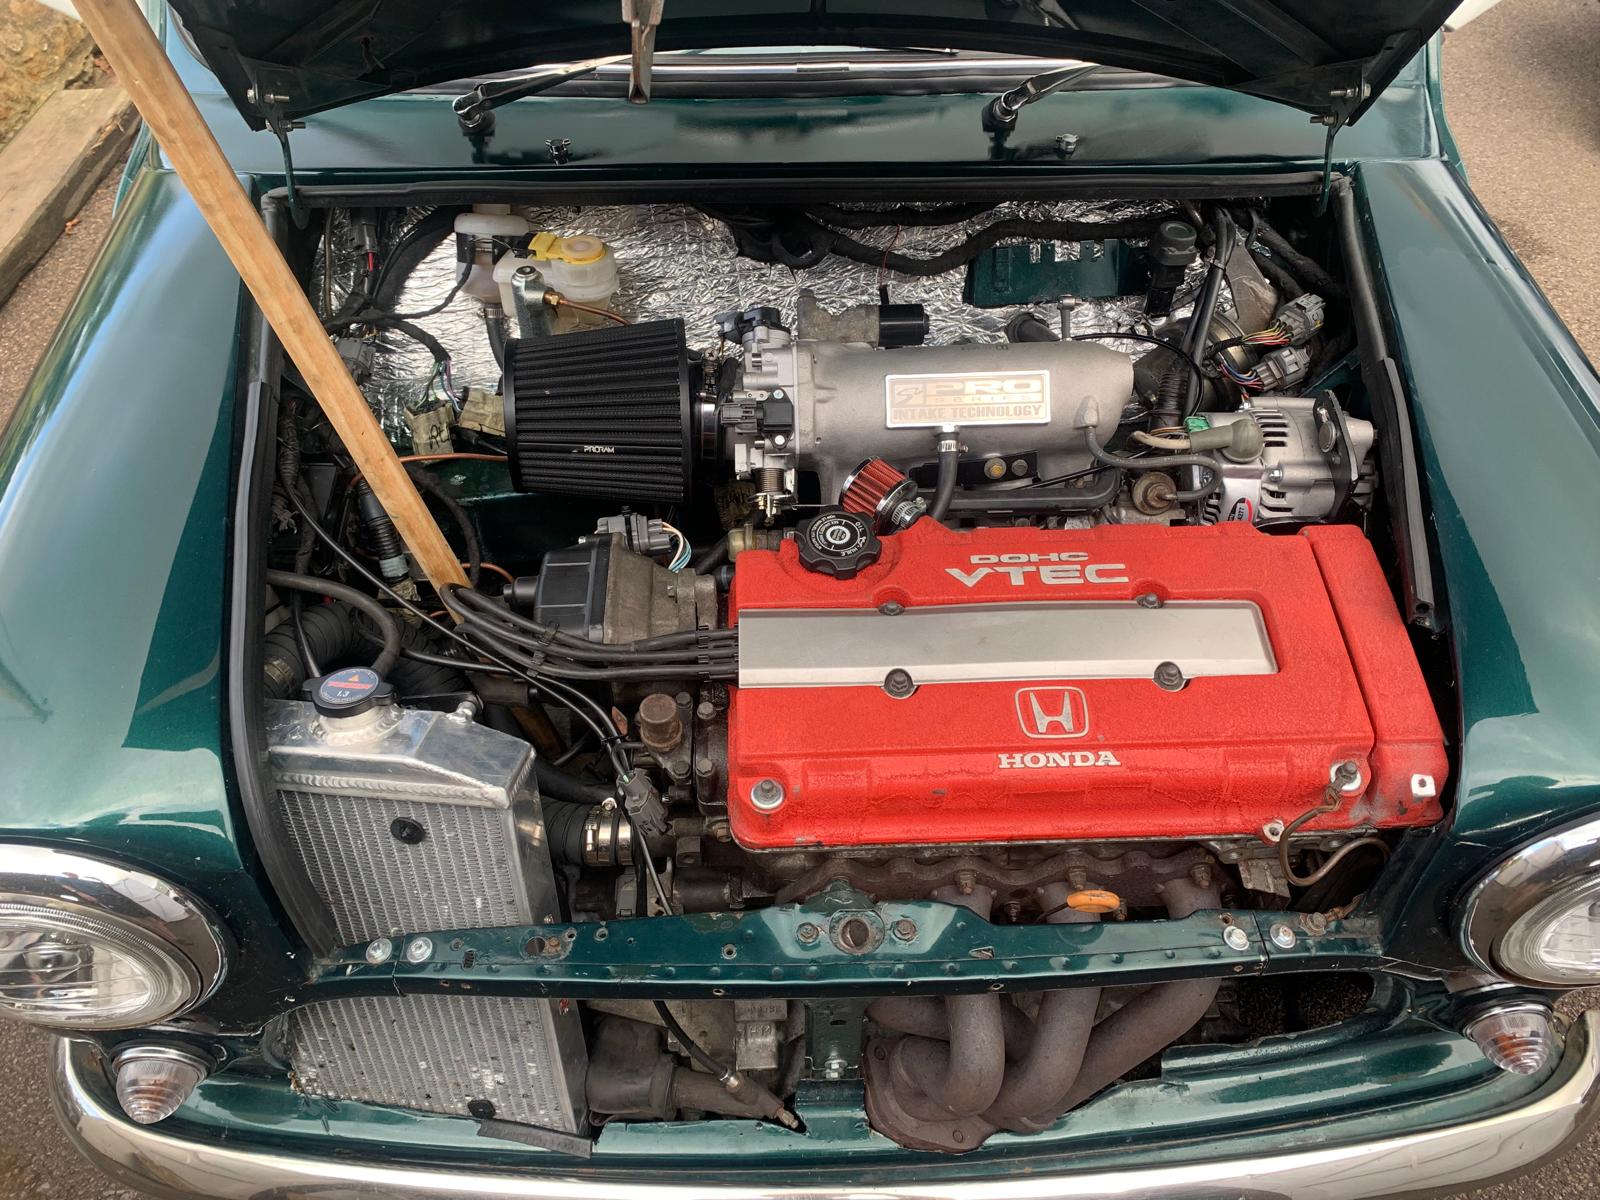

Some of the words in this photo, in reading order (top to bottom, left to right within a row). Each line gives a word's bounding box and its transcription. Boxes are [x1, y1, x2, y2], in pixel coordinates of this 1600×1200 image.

[893, 406, 947, 420] INTAKE
[951, 404, 1042, 418] TECHNOLOGY
[970, 552, 1089, 564] DOHC
[944, 564, 1130, 588] VTEC
[998, 751, 1121, 769] HONDA
